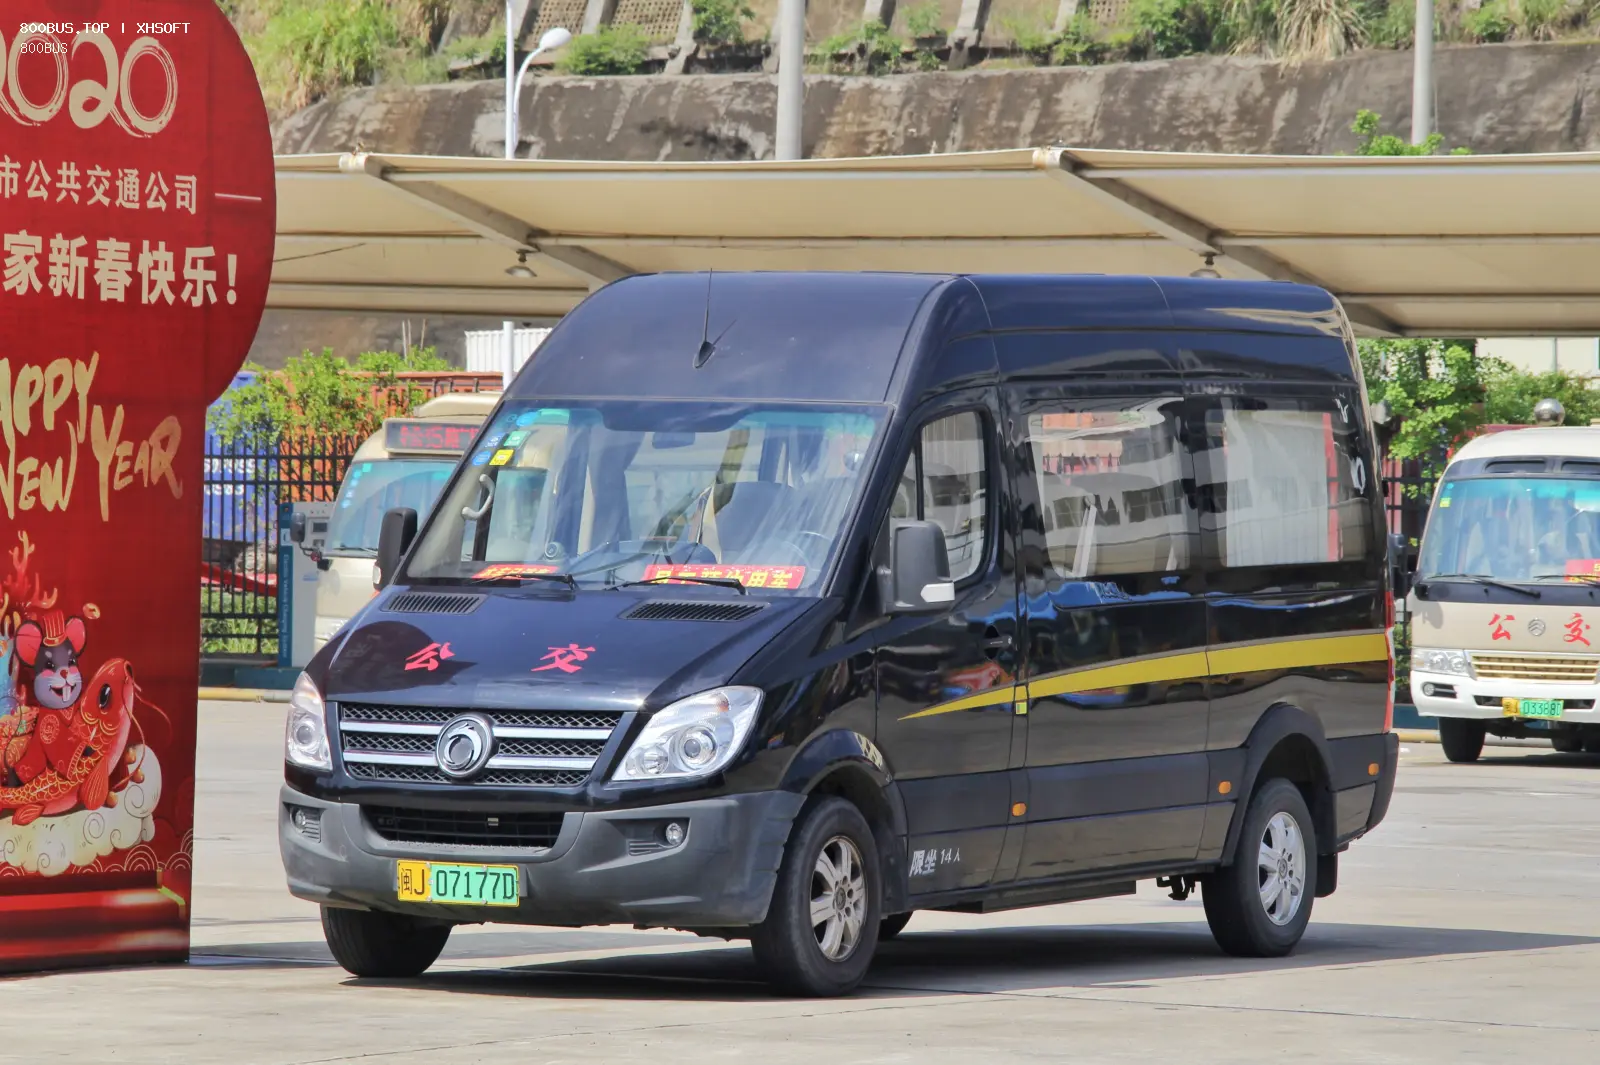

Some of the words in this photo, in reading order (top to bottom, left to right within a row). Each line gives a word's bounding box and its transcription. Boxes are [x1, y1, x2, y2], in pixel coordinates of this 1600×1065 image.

[0, 22, 178, 138] 020
[0, 154, 198, 215] 市公共交通公司
[91, 403, 183, 522] YEAR
[1488, 614, 1515, 641] 公
[1563, 612, 1591, 646] 交
[404, 642, 456, 671] 公
[531, 643, 596, 673] 交
[436, 869, 515, 900] 07177D
